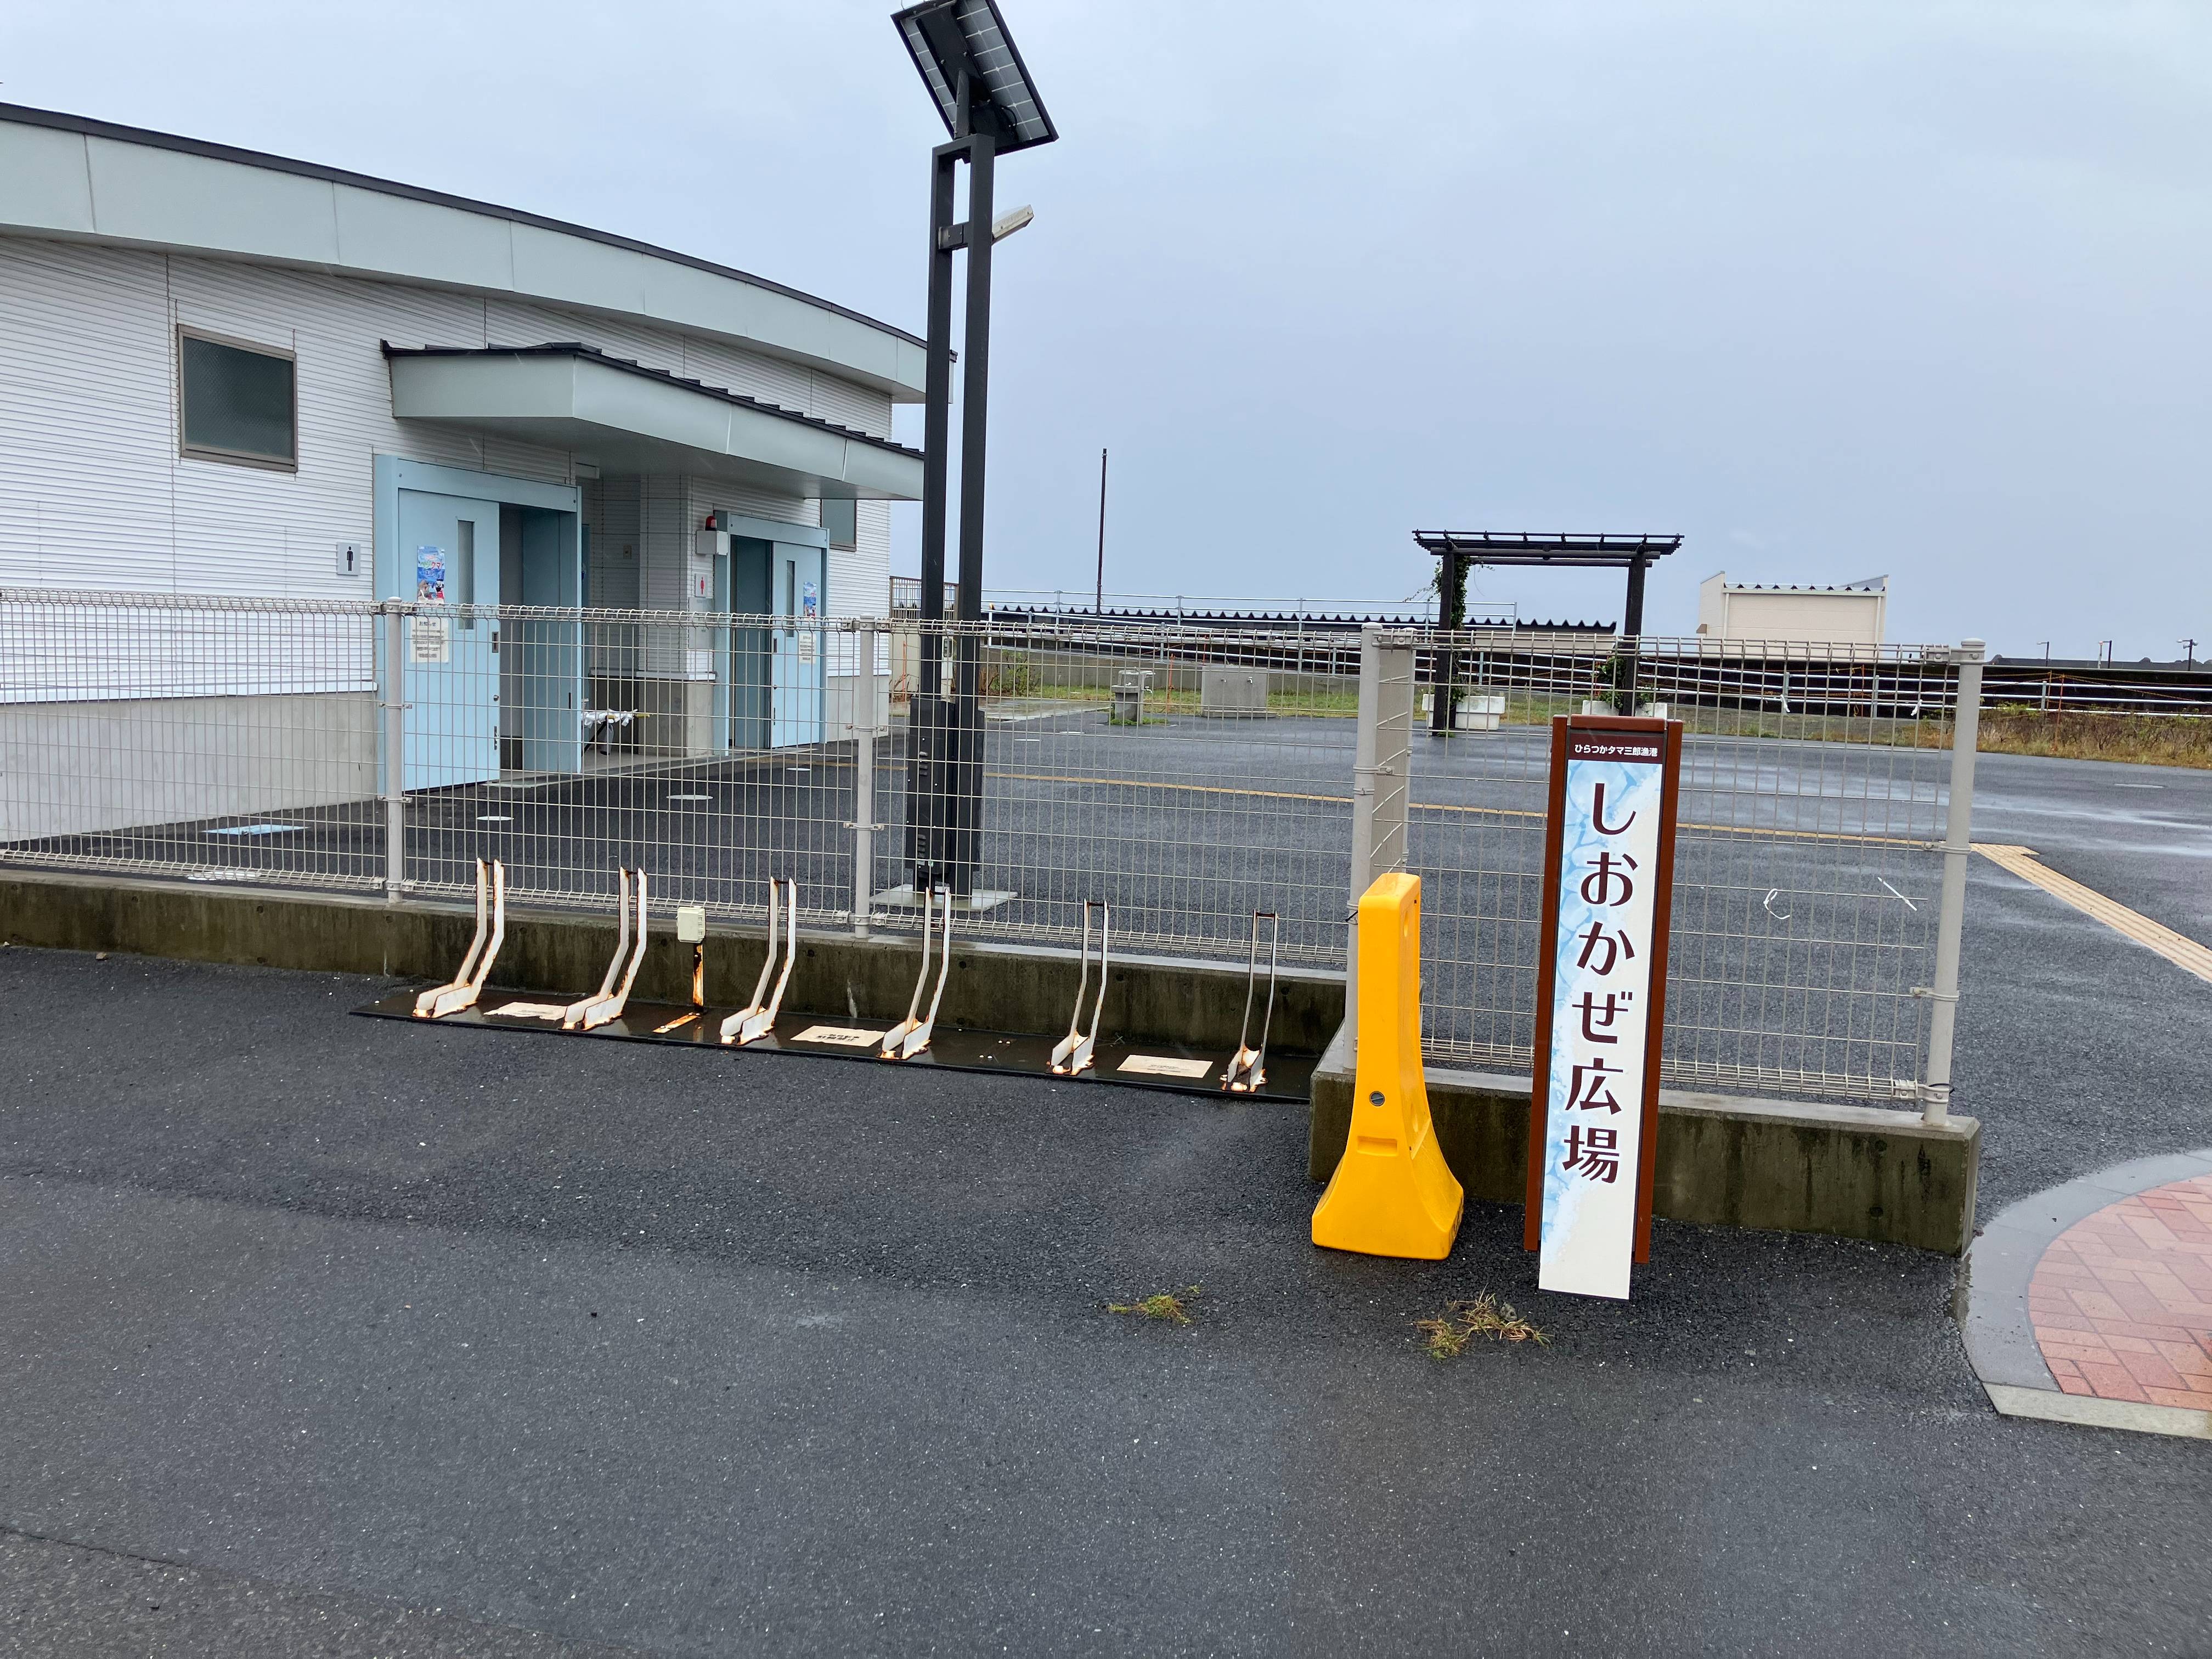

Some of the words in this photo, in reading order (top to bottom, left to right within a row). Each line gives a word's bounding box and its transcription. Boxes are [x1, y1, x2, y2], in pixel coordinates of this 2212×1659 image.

[1575, 744, 1658, 757] ひらつかタマ三郎漁港
[1562, 783, 1637, 1184] しおかぜ広場
